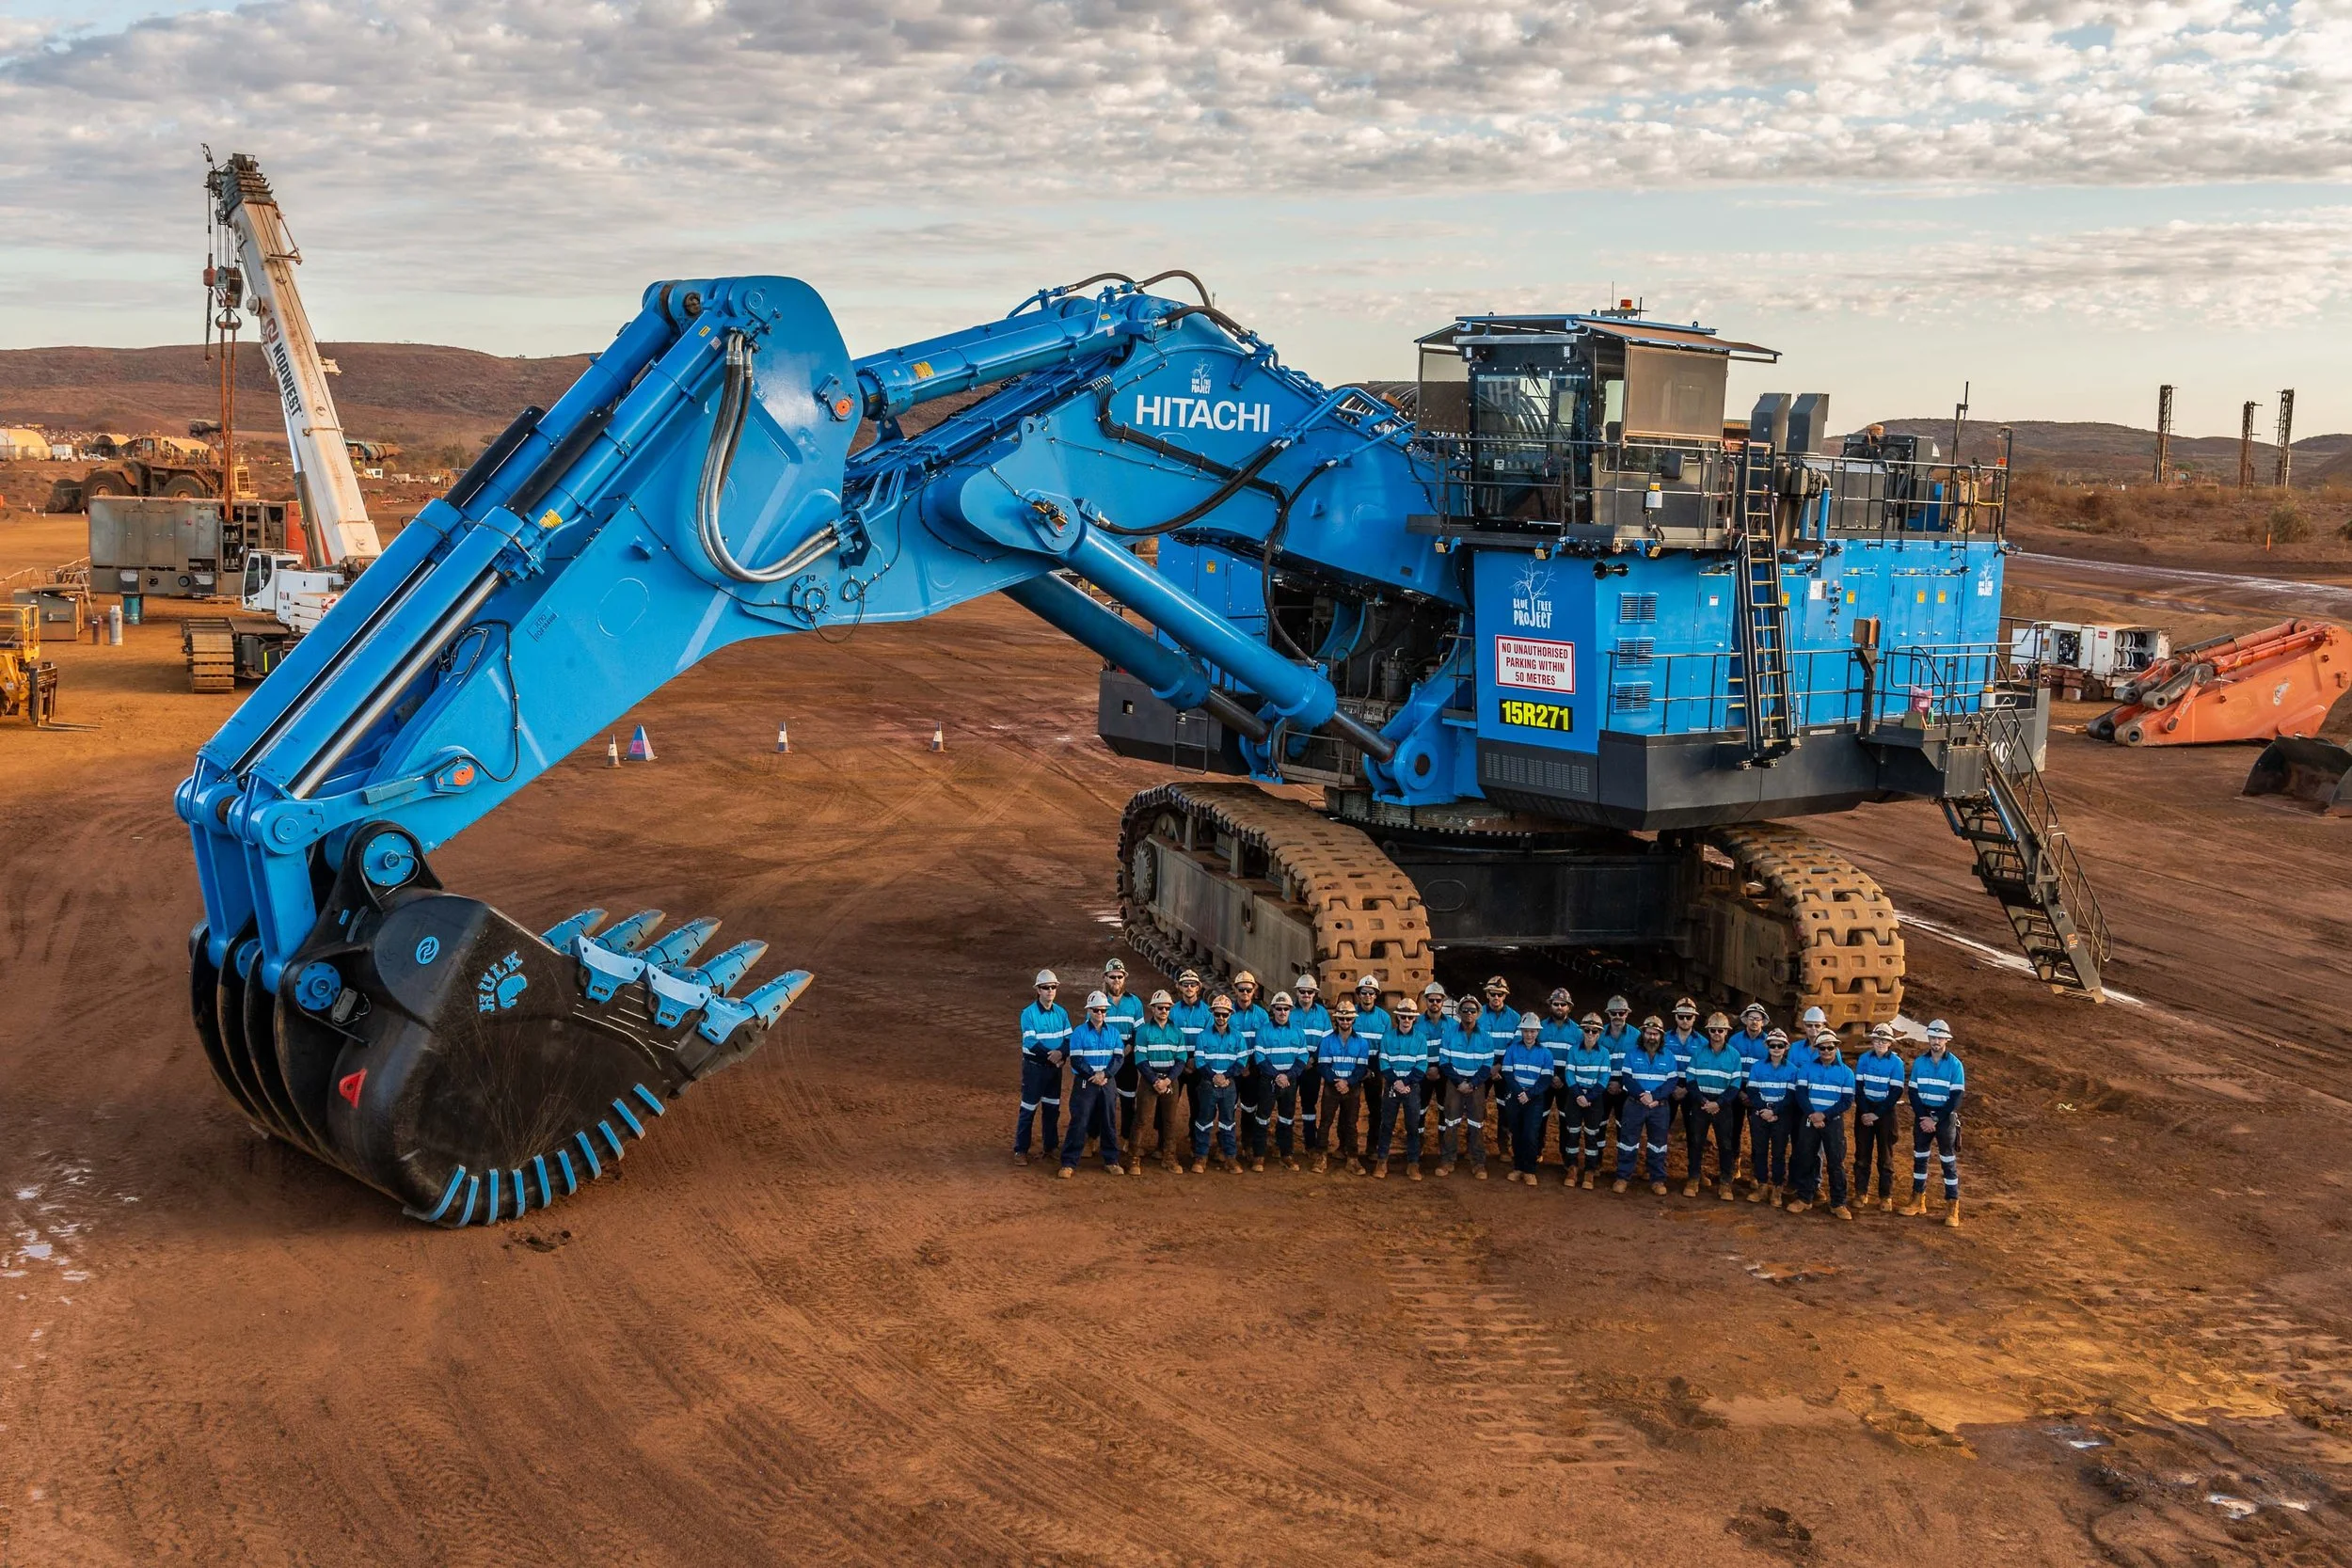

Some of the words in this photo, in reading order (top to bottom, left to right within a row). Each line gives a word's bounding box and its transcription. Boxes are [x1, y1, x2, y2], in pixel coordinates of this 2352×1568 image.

[273, 342, 302, 416] NORWEST
[1136, 394, 1270, 433] HITACHI
[1513, 597, 1528, 610] BLUE
[1537, 599, 1552, 611] TREE
[1513, 610, 1552, 628] PROJECT
[1502, 642, 1512, 654] NO
[1514, 643, 1568, 659] UNAUTHORISED
[1506, 657, 1536, 670] PARKING
[1538, 660, 1565, 673] WITHIN
[1515, 672, 1525, 682] 50
[1526, 673, 1556, 686] METRES
[1502, 700, 1569, 731] 15R271
[478, 950, 524, 1013] HULK
